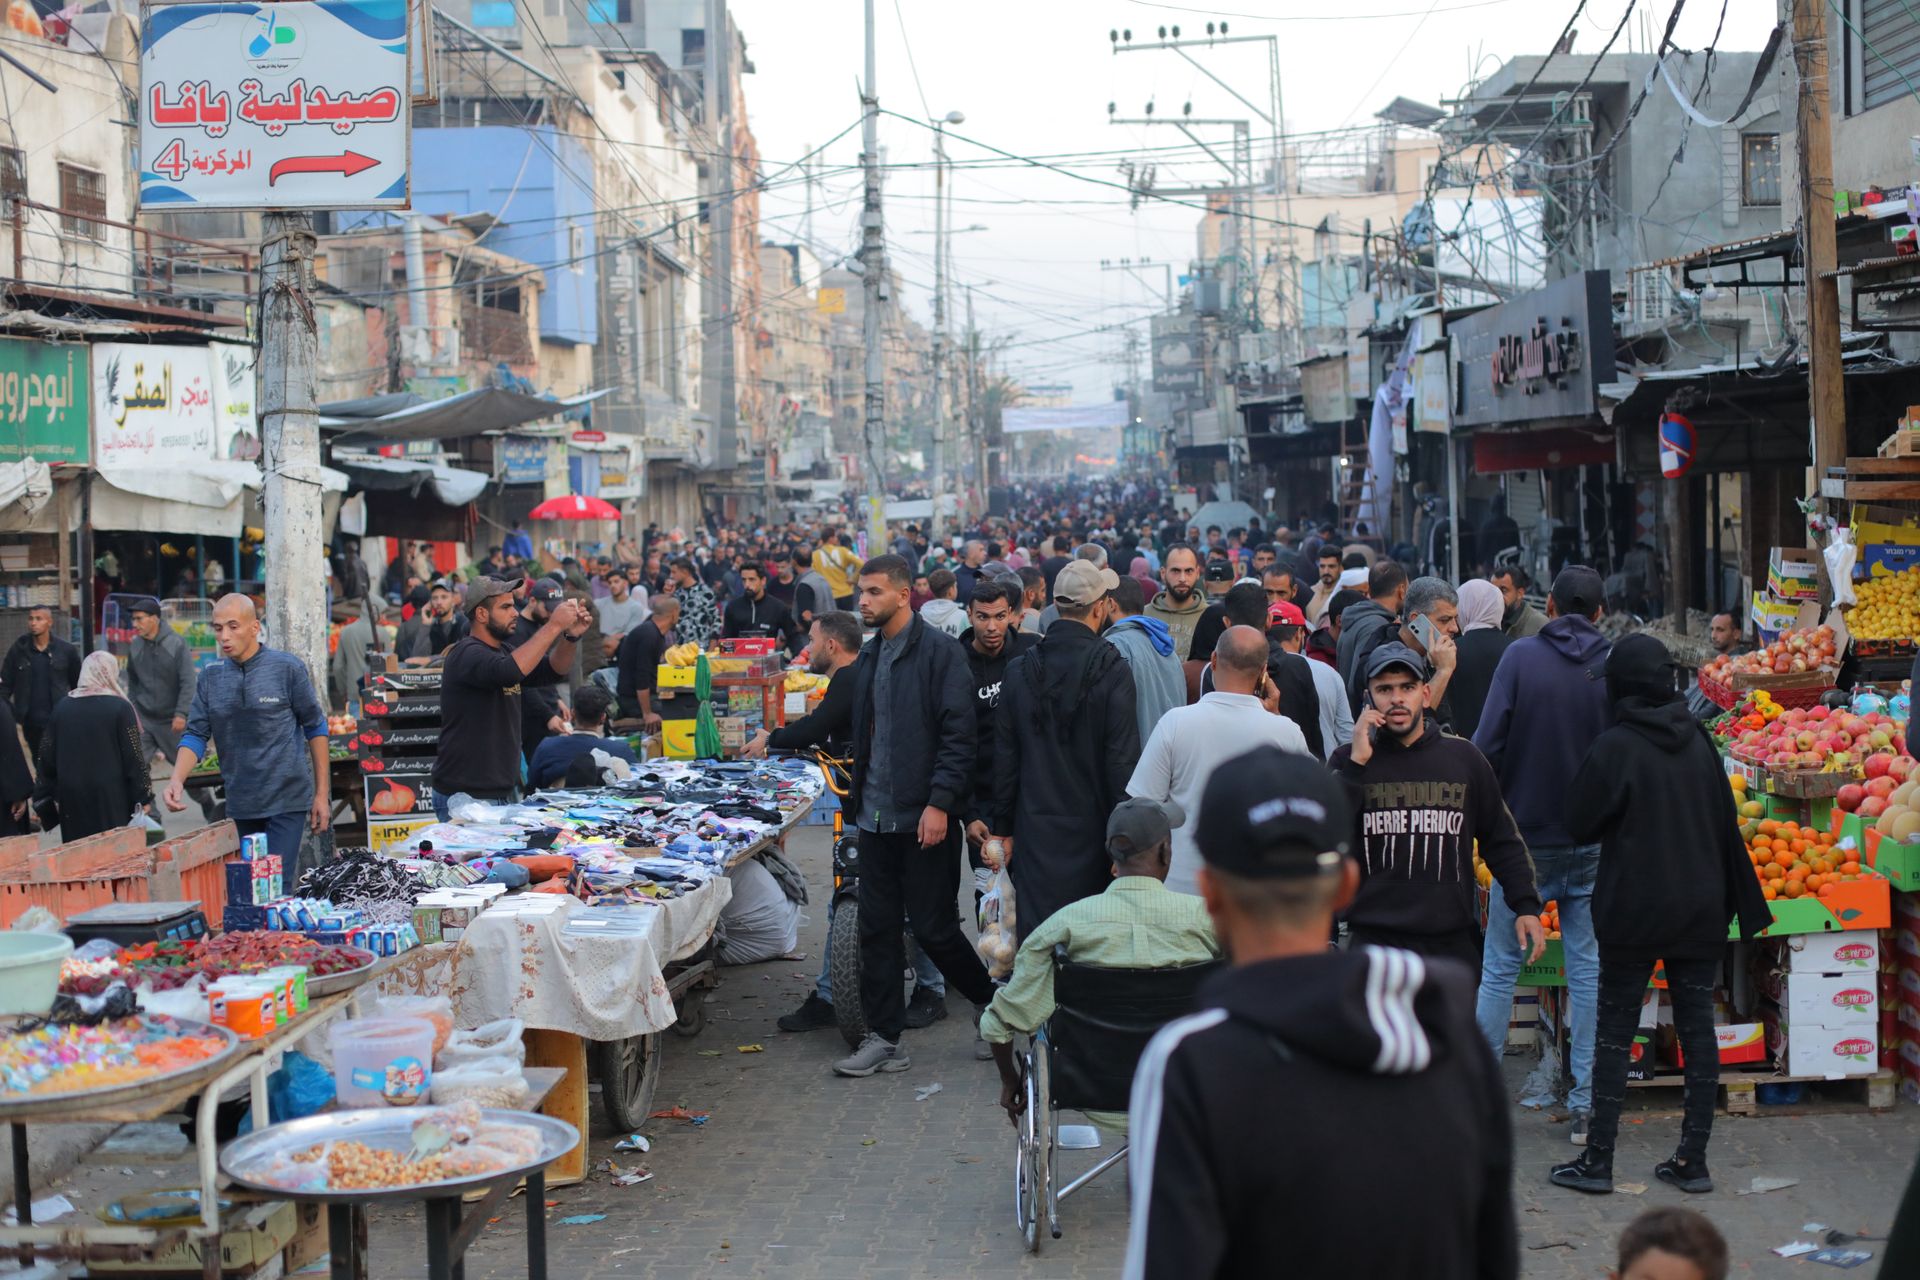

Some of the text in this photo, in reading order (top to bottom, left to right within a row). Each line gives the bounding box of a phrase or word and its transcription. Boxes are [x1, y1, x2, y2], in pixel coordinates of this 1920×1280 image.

[151, 80, 399, 135] صيدلية يافا
[154, 140, 251, 180] المركزية 4
[115, 359, 209, 429] متجر الصقر
[1363, 810, 1408, 836] PIERRE
[1524, 966, 1556, 975] הדרום
